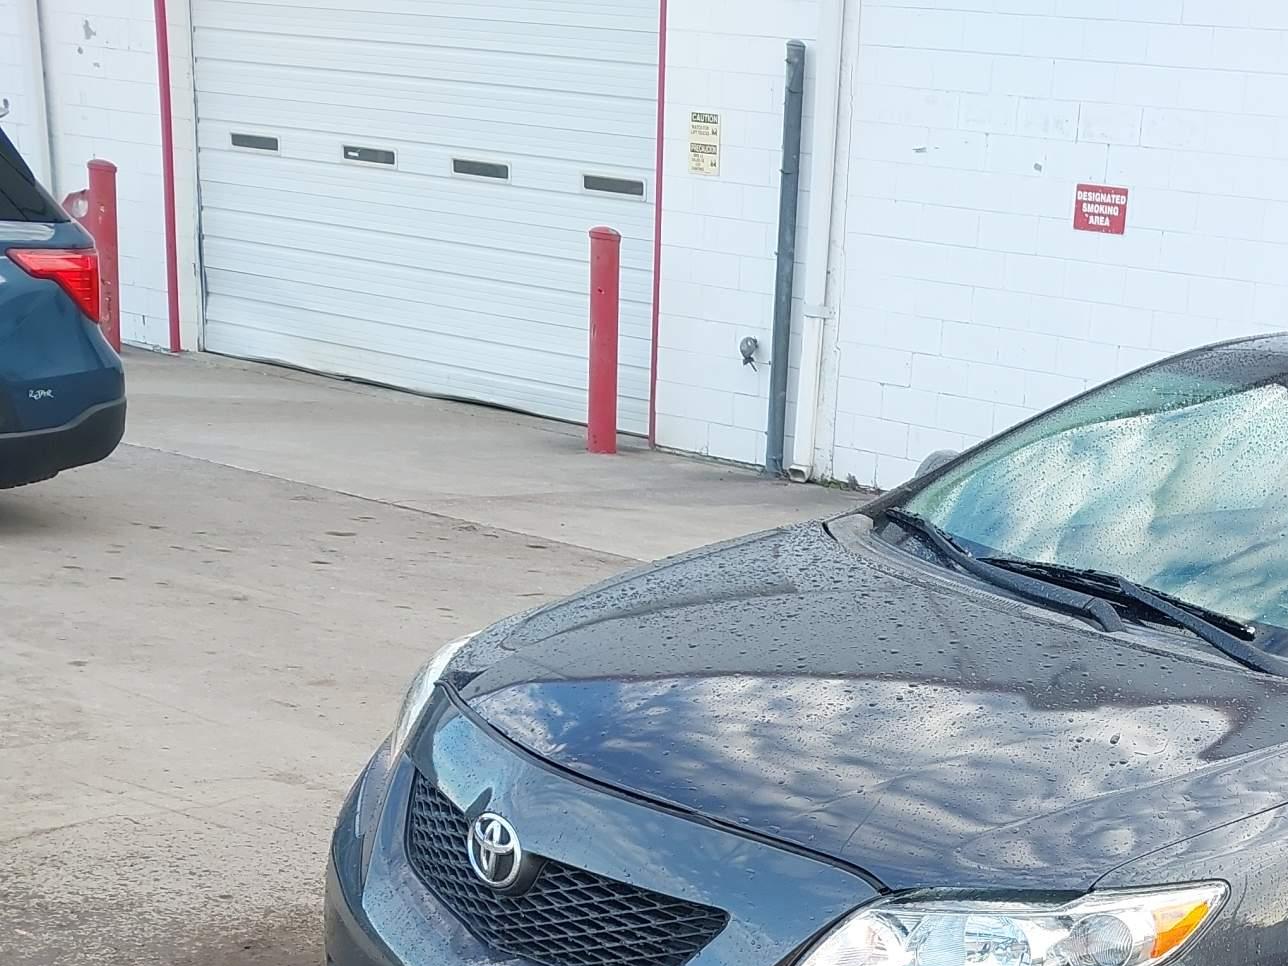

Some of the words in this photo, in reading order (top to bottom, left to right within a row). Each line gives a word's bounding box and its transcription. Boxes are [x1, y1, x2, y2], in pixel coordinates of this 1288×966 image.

[692, 113, 718, 123] CAUTION
[1077, 191, 1126, 204] DESIGNATED
[1082, 203, 1119, 216] SMOKING
[1088, 215, 1110, 227] AREA
